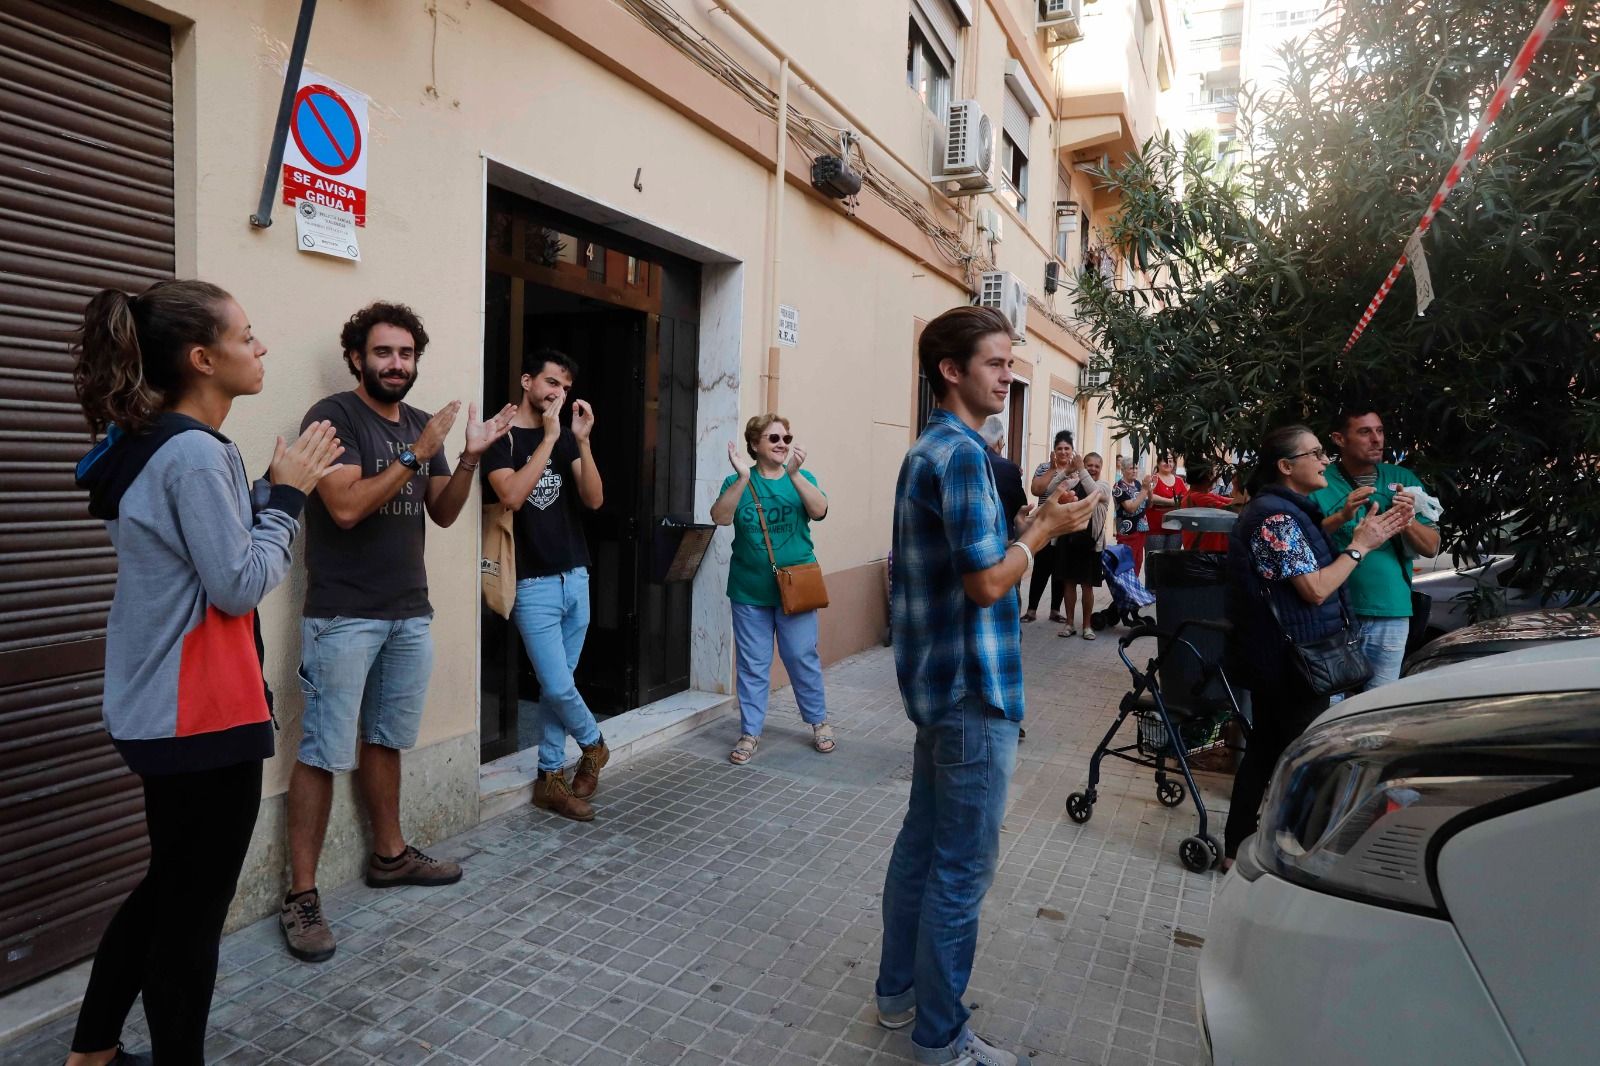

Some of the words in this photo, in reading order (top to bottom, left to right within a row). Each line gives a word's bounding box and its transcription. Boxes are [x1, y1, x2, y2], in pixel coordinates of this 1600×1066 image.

[293, 171, 311, 186] SE
[315, 179, 356, 201] AVISA
[305, 190, 345, 211] GRUA
[586, 242, 594, 261] 4
